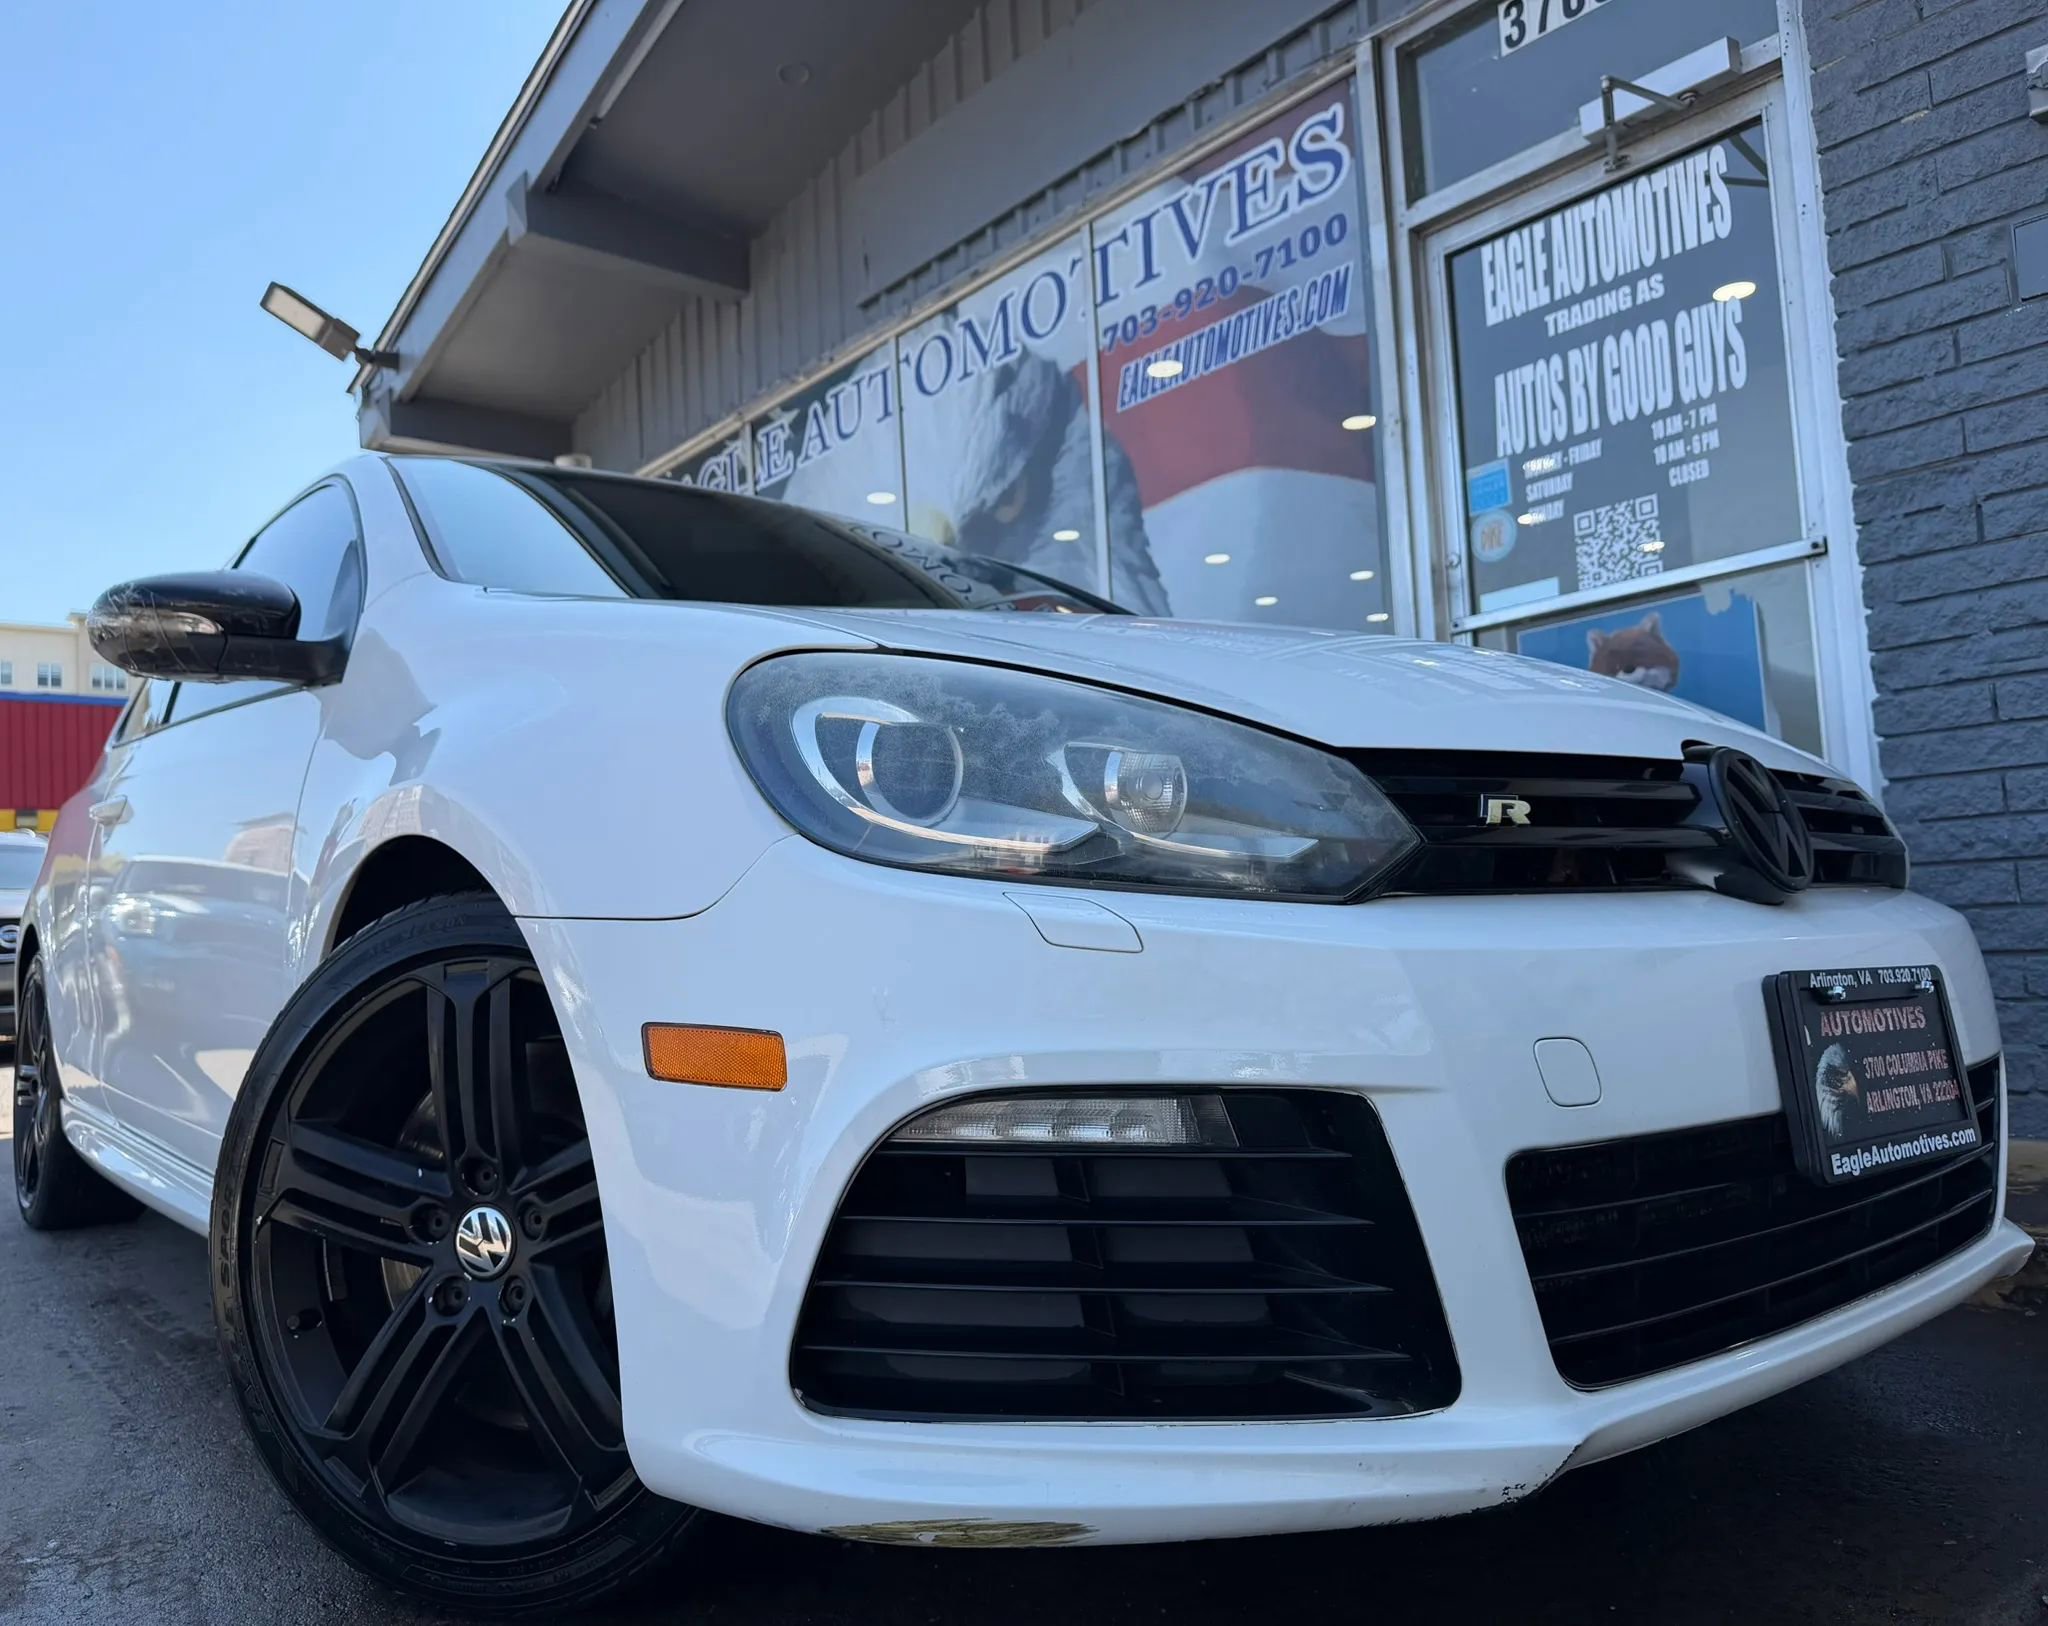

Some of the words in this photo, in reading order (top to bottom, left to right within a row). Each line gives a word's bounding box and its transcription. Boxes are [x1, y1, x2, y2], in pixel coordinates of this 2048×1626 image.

[1503, 0, 1607, 49] 37
[1480, 222, 1552, 328] EAGLE
[1551, 144, 1733, 301] AUTOMOTIVES
[663, 422, 795, 493] GLE
[798, 103, 1352, 466] AUTOMOTIVES
[1102, 212, 1348, 353] 703-920-7100
[1544, 285, 1633, 337] TRADING
[1636, 272, 1666, 306] AS
[1118, 264, 1352, 411] EAGLEAUTOMOTIVES.COM
[1494, 353, 1568, 458] AUTOS
[1567, 341, 1601, 436] BY
[1602, 318, 1674, 427] GOOD
[1675, 296, 1748, 405] GUYS
[1525, 472, 1574, 503] SATURDAY
[1668, 458, 1710, 488] CLOSED
[1485, 799, 1532, 825] R
[1810, 971, 1858, 989] Arlington,
[1857, 971, 1873, 985] VA
[1820, 1005, 1927, 1037] AUTOMOTIVES
[1886, 1051, 1928, 1076] COLUMBIA
[1866, 1085, 1921, 1113] ARLINGTON,
[1920, 1082, 1934, 1104] VA
[1831, 1126, 1977, 1176] EagleAutomotives.com
